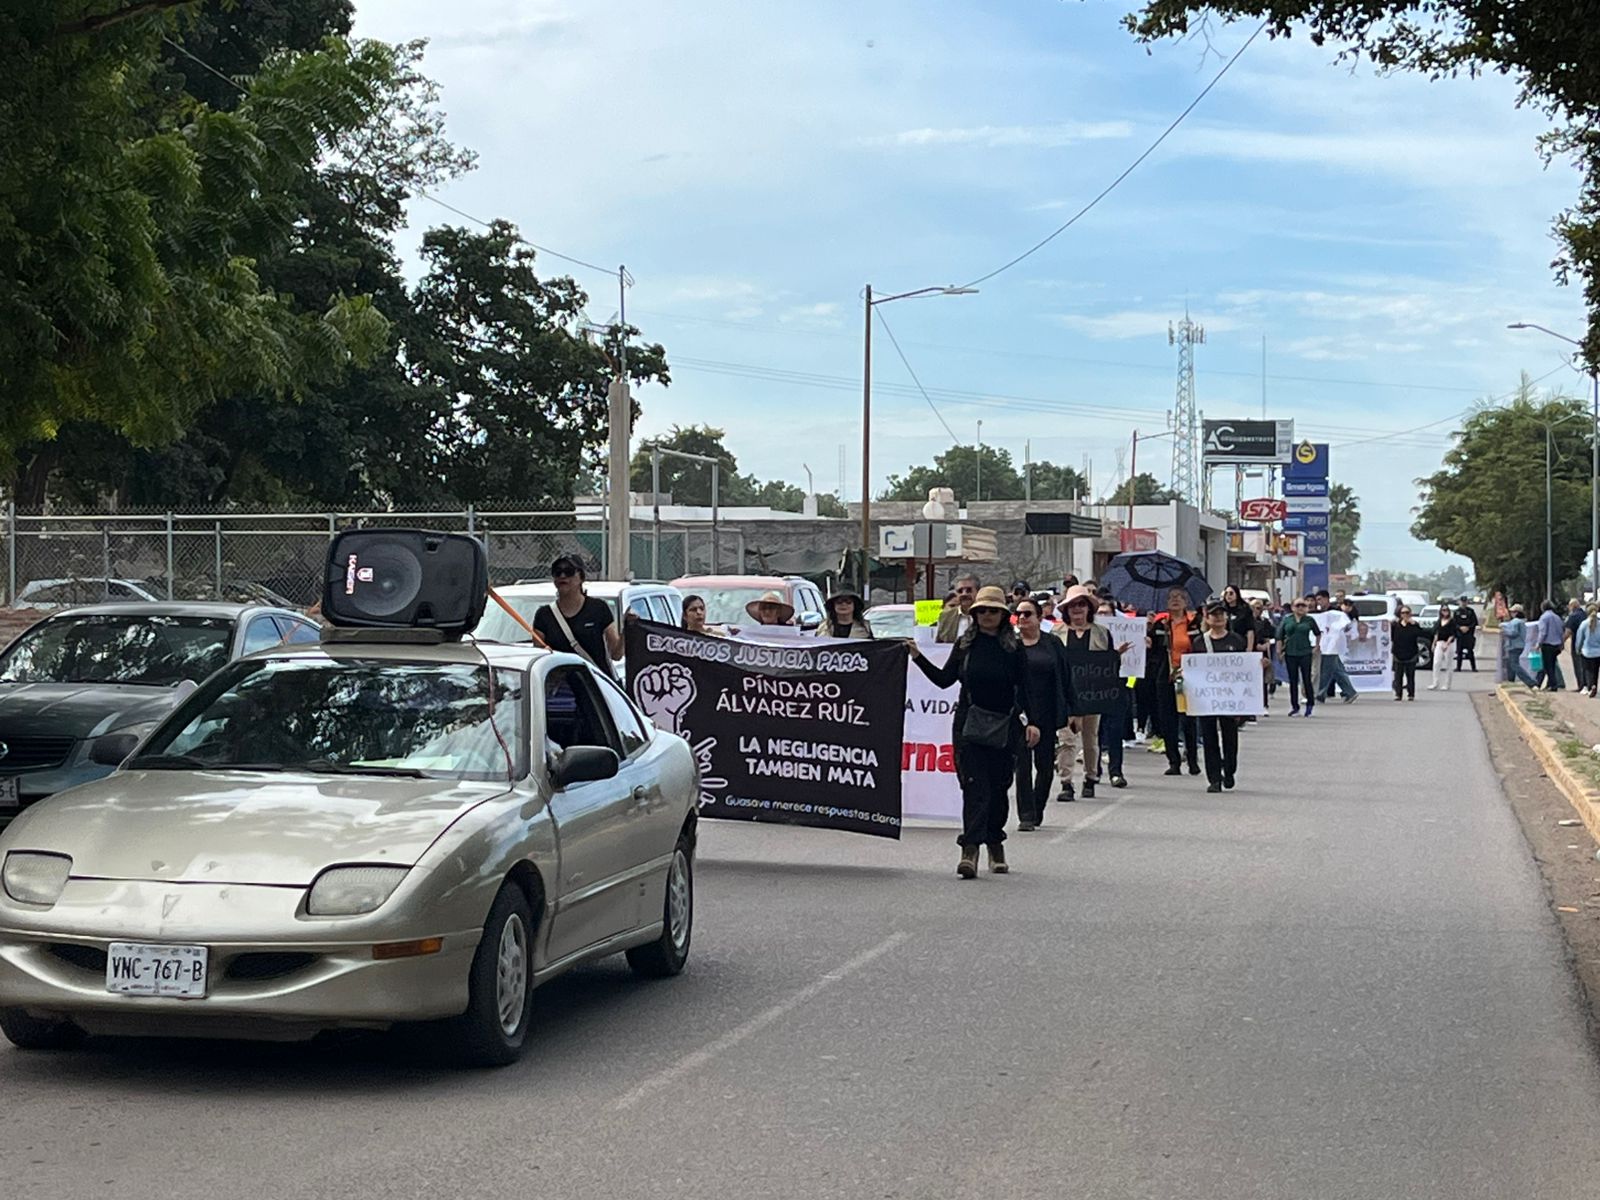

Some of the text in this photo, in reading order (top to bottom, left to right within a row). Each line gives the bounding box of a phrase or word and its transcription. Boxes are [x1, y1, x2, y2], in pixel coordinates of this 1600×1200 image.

[647, 634, 869, 672] EXIGIMOS JUSTICIA PARA:
[743, 674, 841, 699] PÍNDARO
[716, 688, 813, 719] ÁLVAREZ
[920, 699, 959, 715] VIDA
[739, 735, 878, 767] LA NEGLIGENCIA
[745, 758, 876, 789] TAMBIEN MATA
[725, 795, 901, 826] Guasave merece respuestas claras
[112, 956, 203, 982] VNC-767-B
